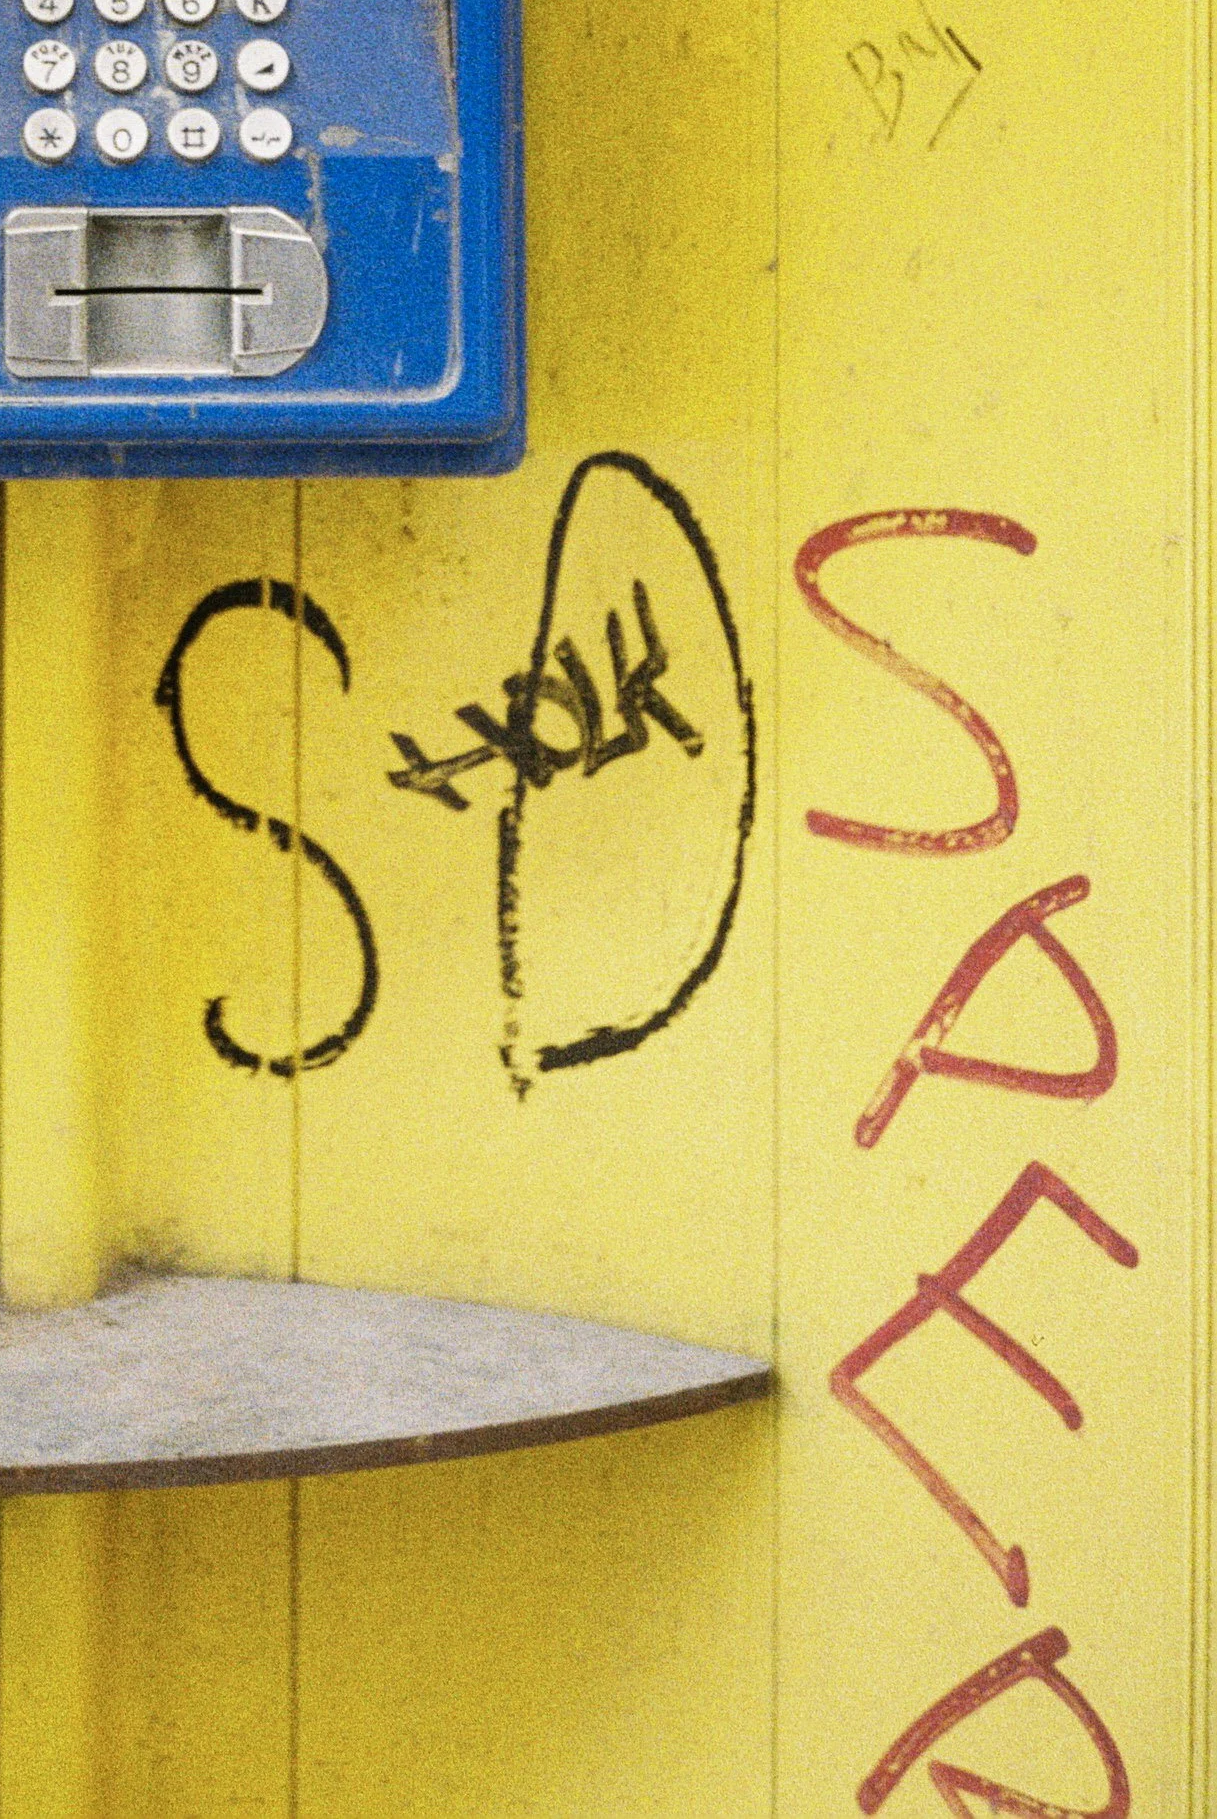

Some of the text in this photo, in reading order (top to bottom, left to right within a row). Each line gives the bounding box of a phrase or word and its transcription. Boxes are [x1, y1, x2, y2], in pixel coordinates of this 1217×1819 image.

[41, 60, 58, 84] 7
[112, 60, 131, 84] 8
[182, 60, 201, 84] 9
